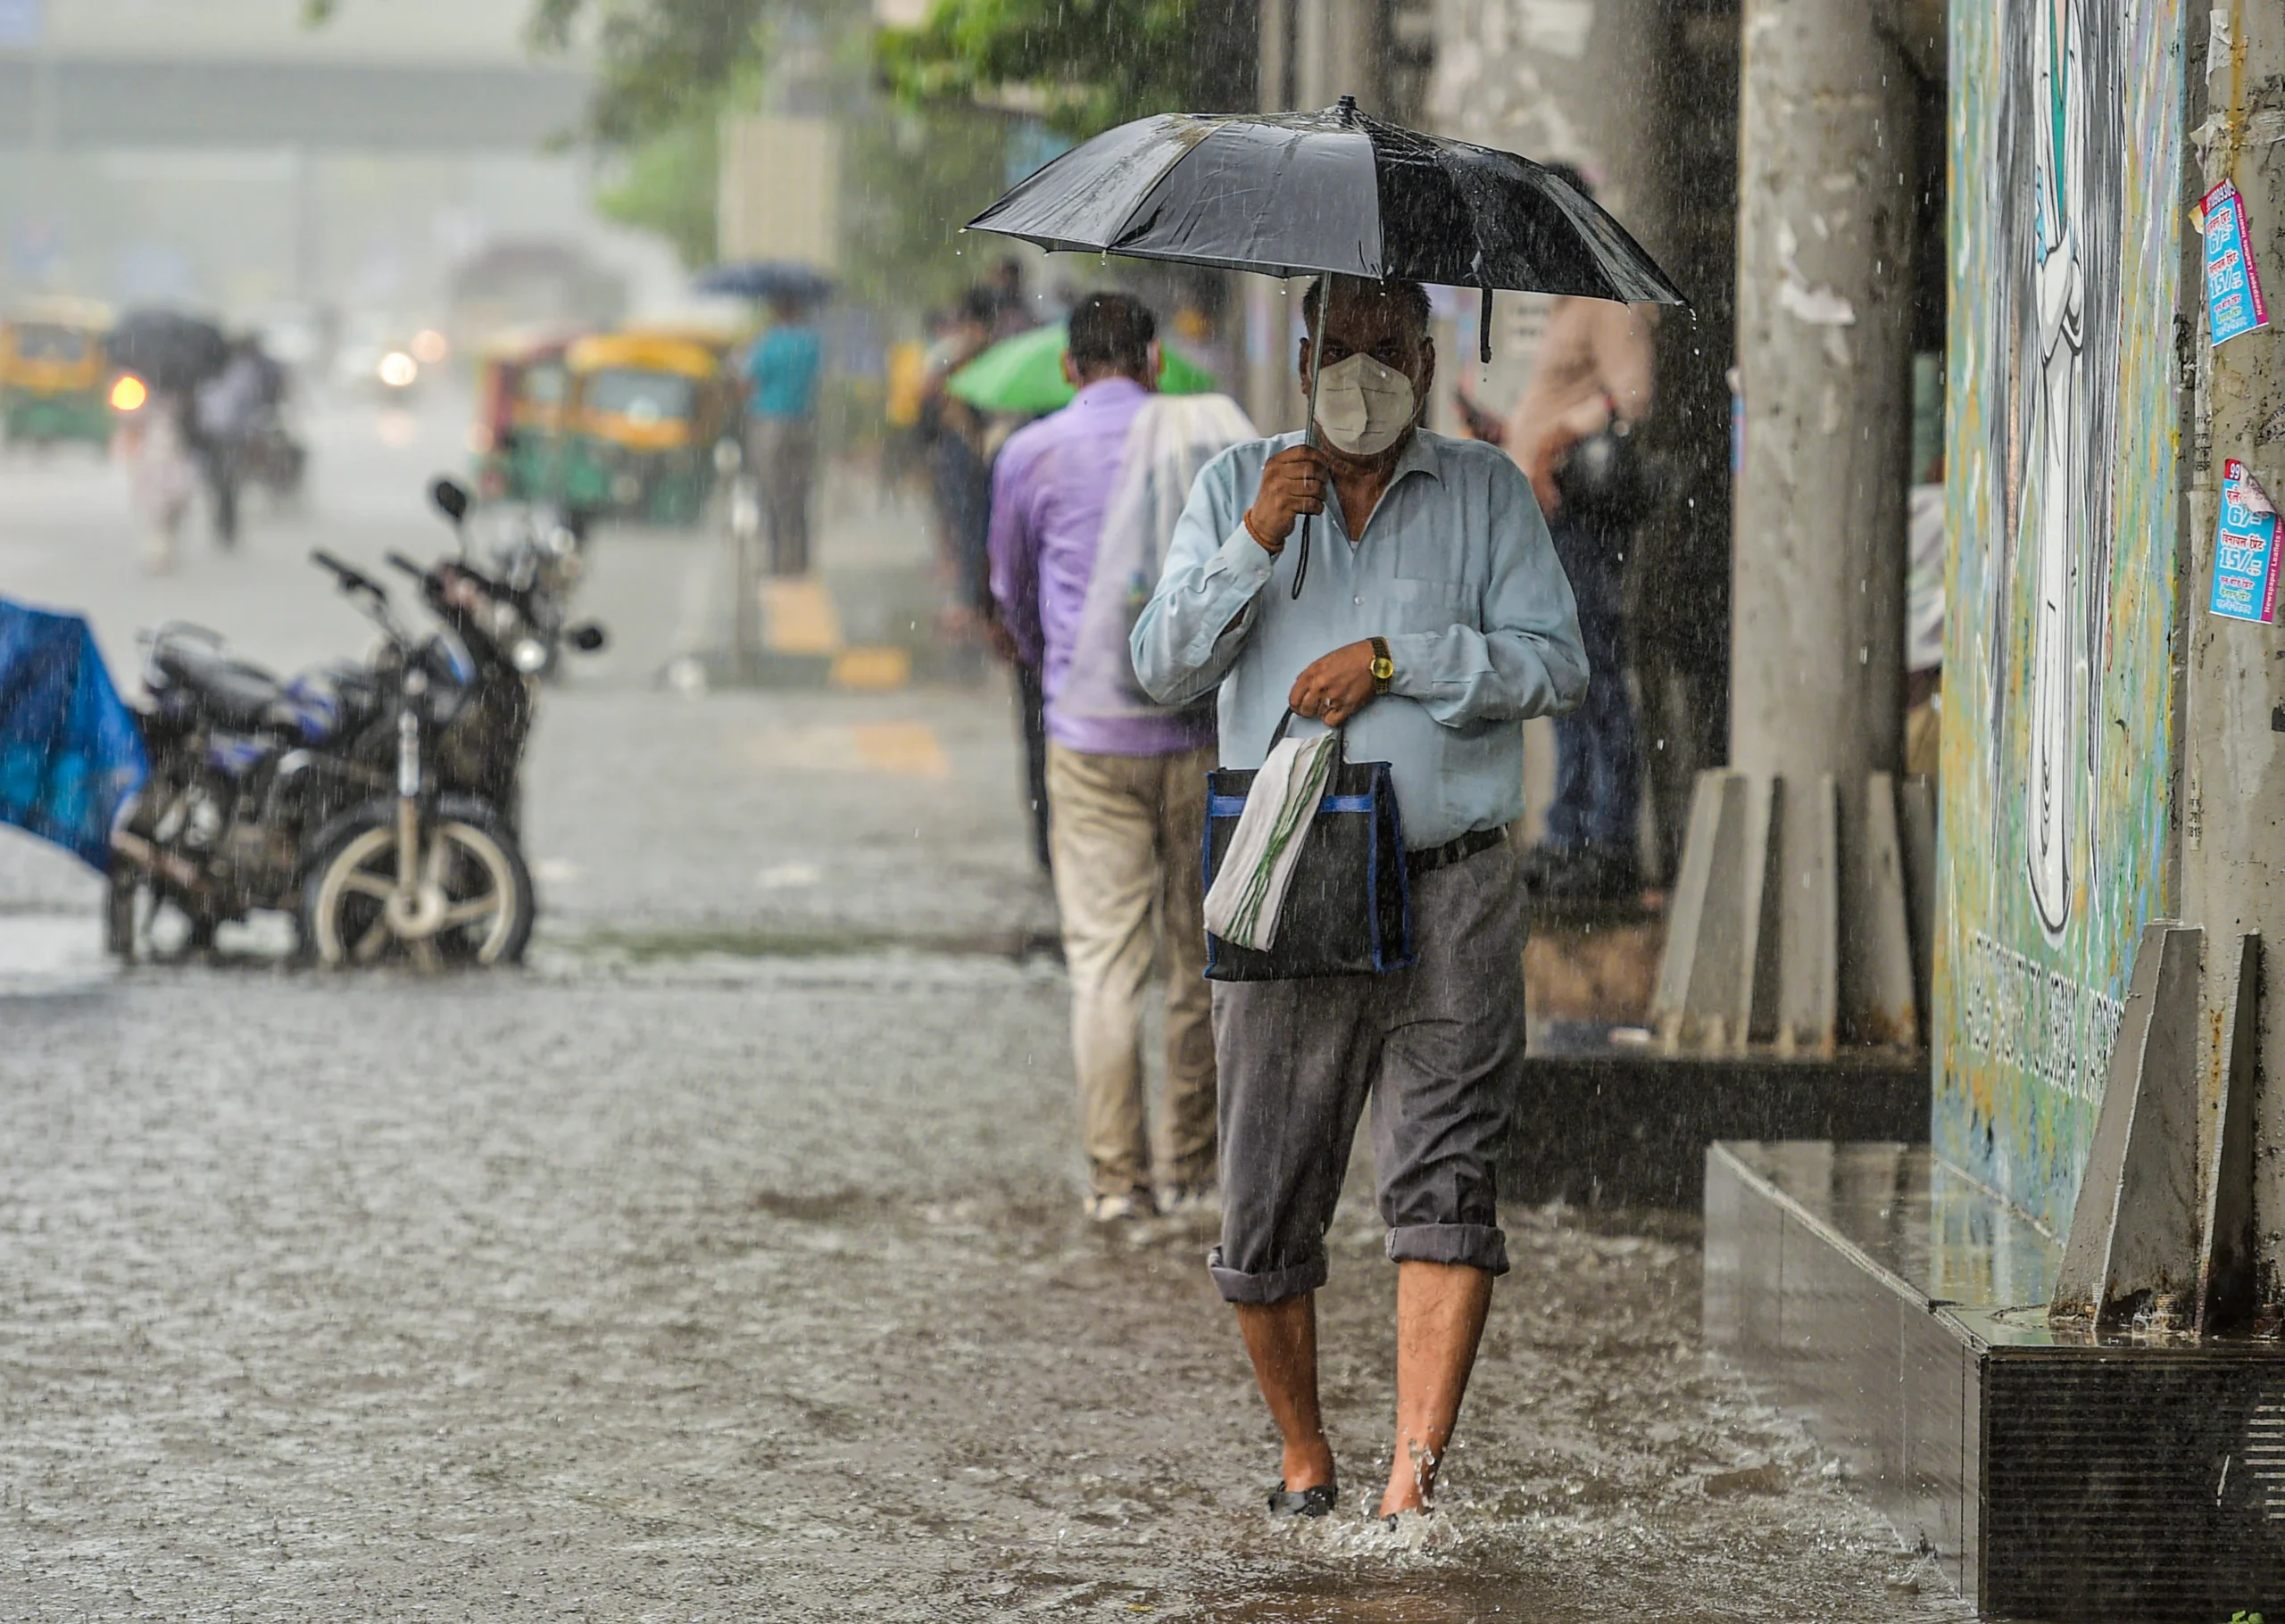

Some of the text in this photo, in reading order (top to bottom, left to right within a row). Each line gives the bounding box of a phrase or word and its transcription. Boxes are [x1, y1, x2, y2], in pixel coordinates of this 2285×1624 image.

[2236, 203, 2263, 315] Newspaper Leaflets Insertion
[2264, 568, 2276, 613] Newspaper
[2272, 537, 2281, 568] Leaflets
